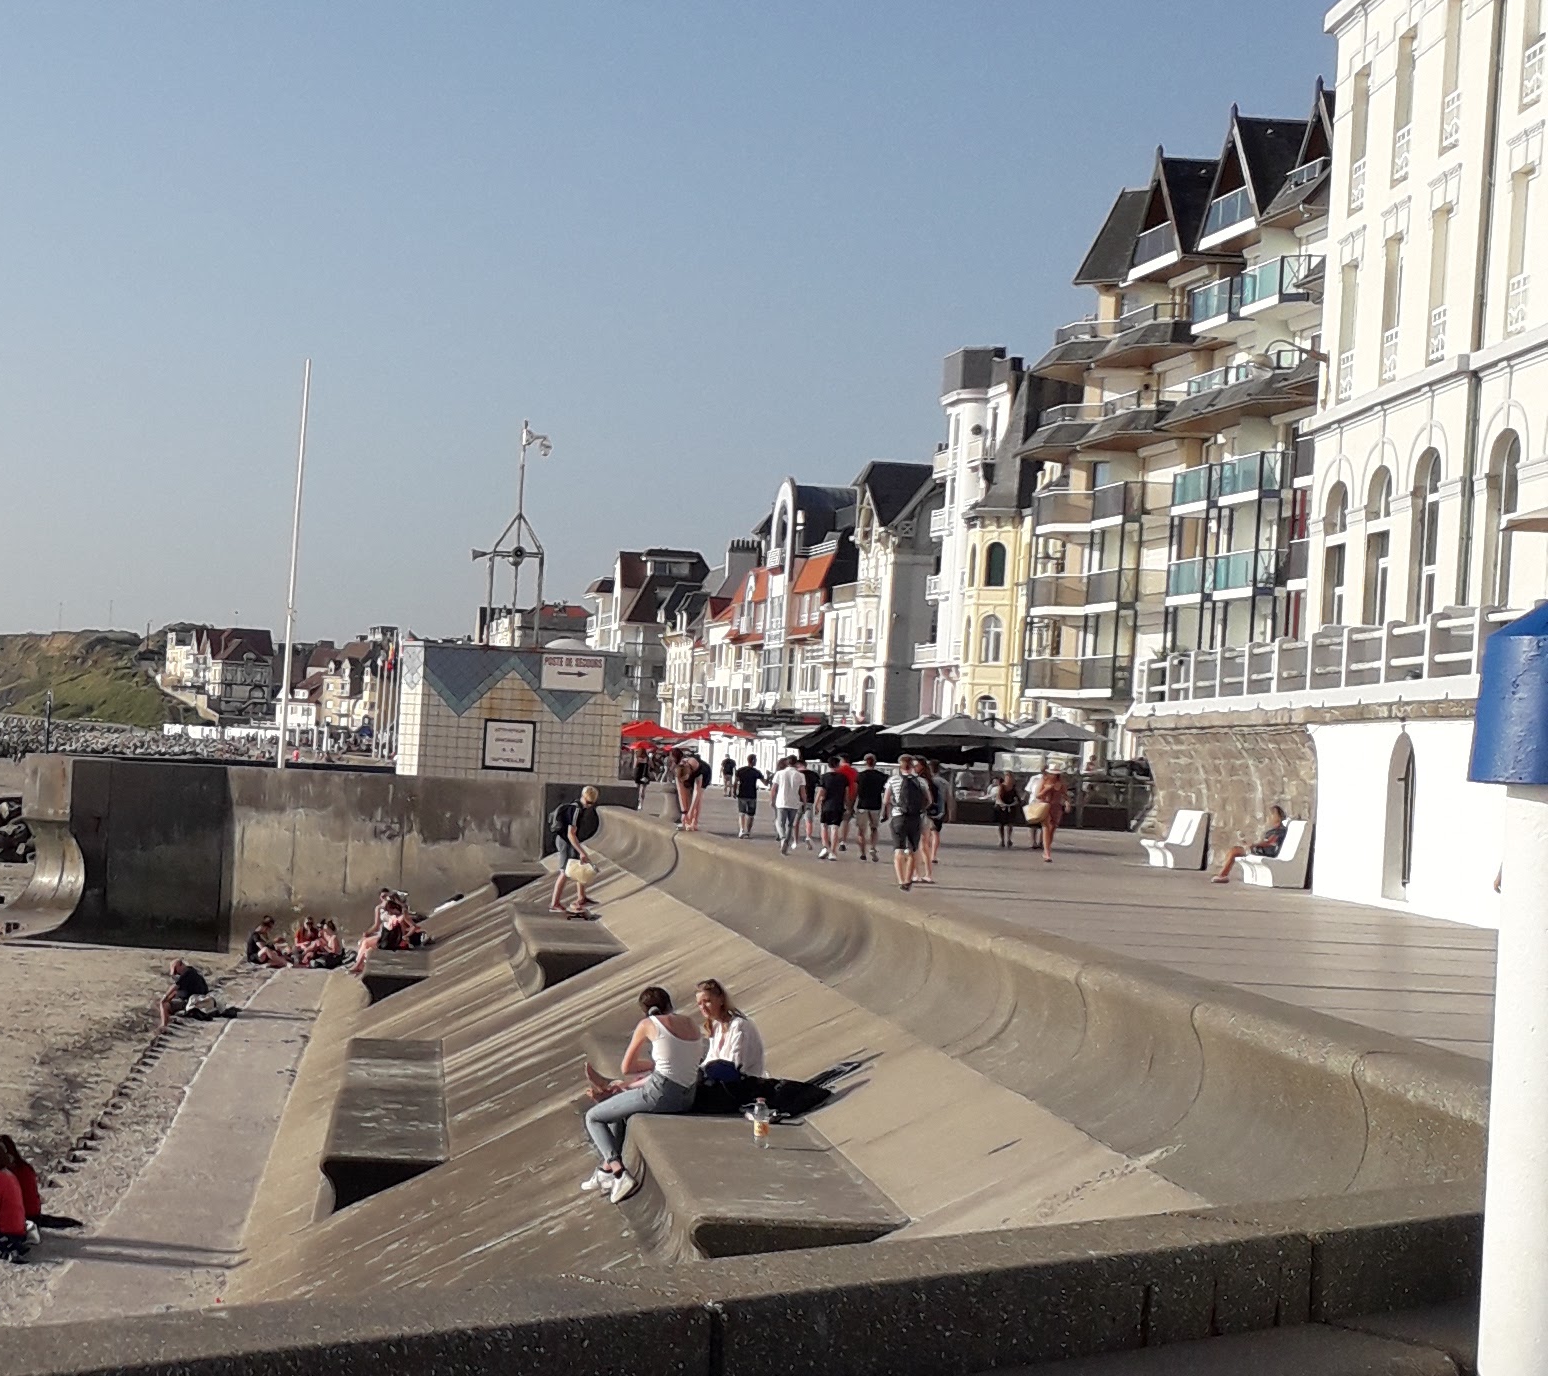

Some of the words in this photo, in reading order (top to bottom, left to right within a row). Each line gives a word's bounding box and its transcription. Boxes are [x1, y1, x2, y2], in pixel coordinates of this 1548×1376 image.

[545, 657, 563, 666] POSTE
[565, 658, 573, 667] DE
[575, 658, 602, 668] SECOURS
